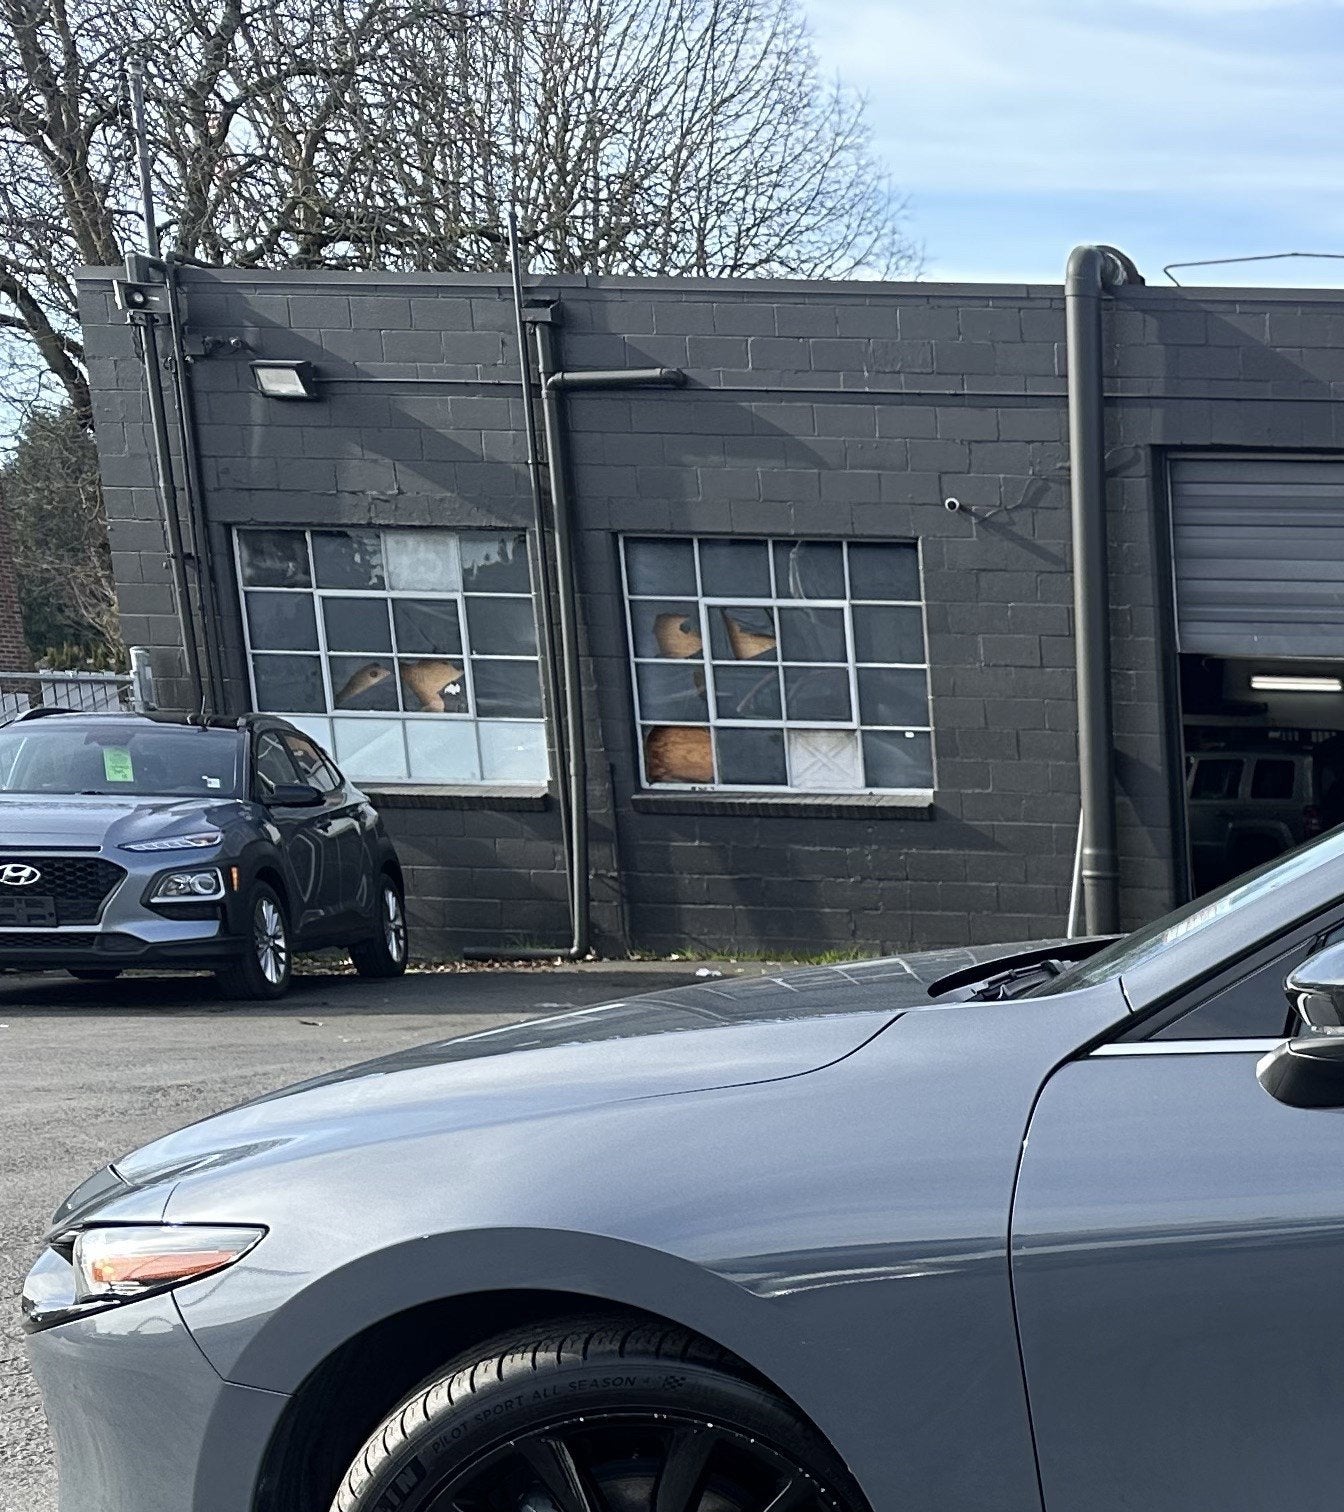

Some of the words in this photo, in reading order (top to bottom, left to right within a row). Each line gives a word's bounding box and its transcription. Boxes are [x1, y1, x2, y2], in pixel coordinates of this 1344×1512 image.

[432, 1418, 468, 1453] PILOT
[475, 1396, 523, 1423] SPORT
[532, 1386, 560, 1402] ALL
[568, 1376, 637, 1392] SEASON
